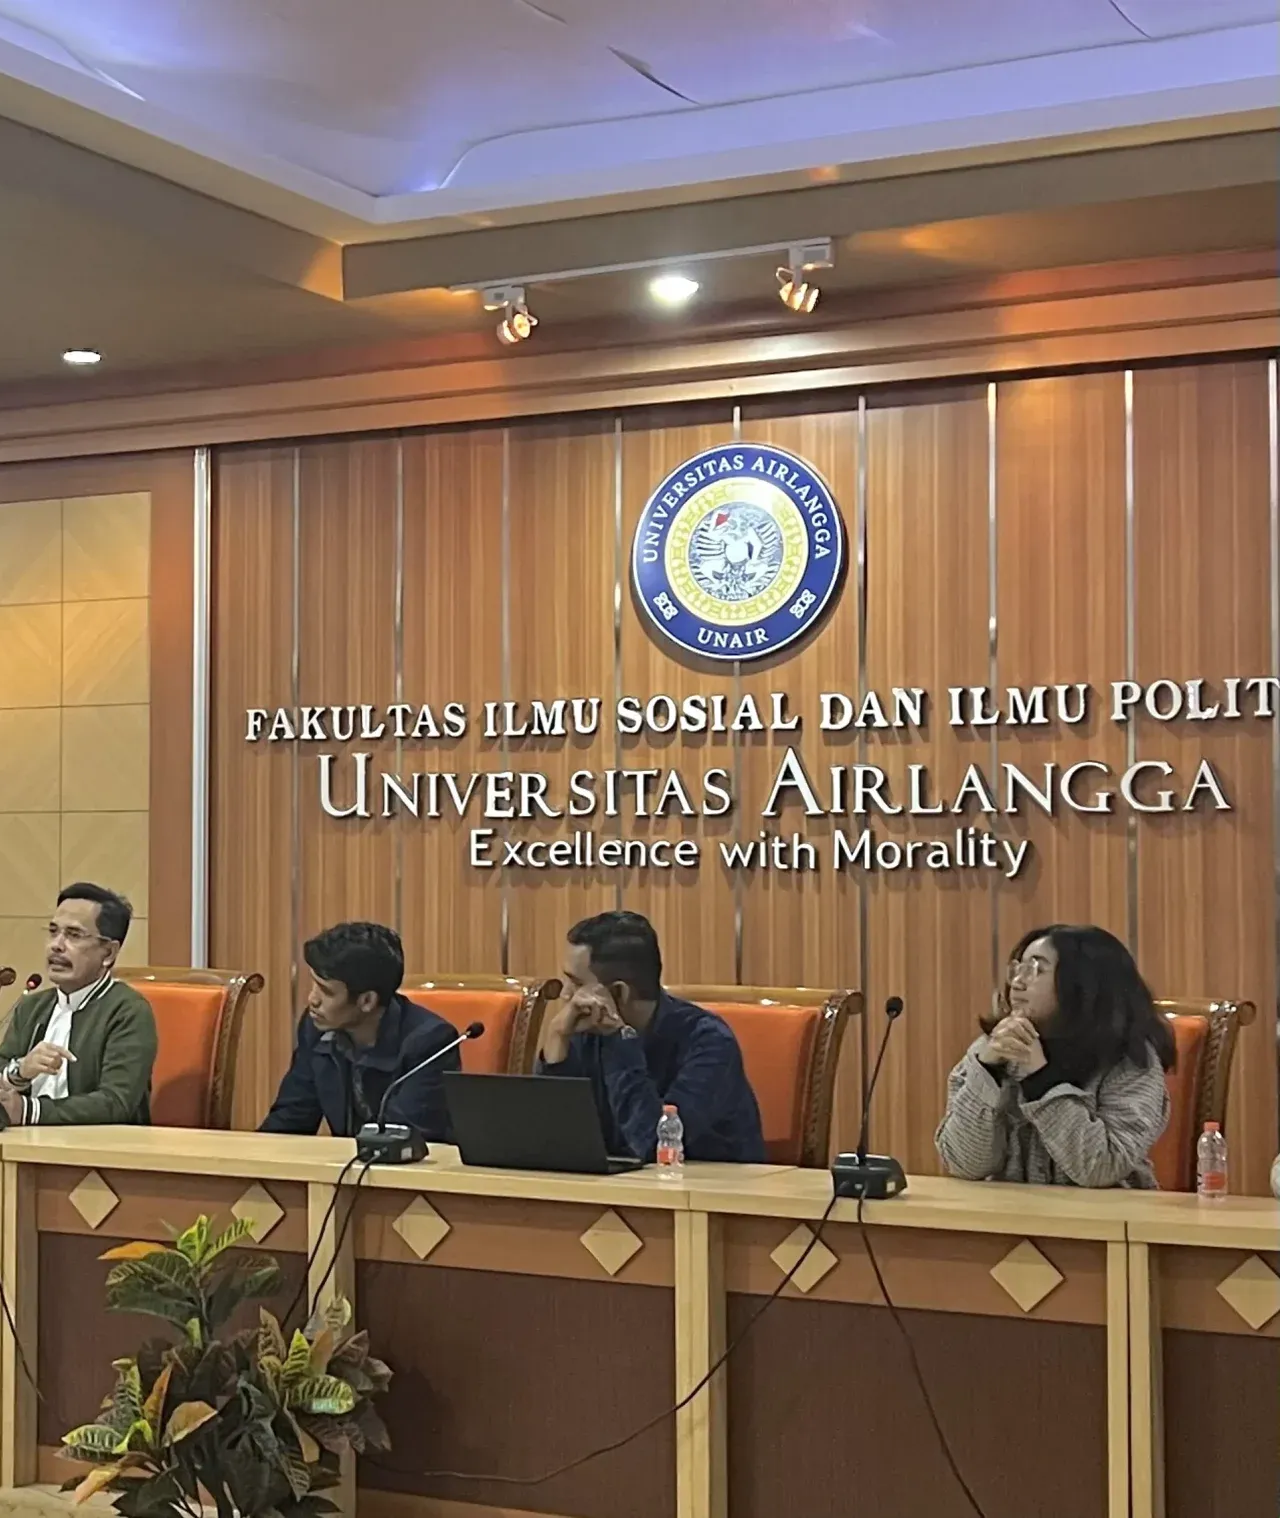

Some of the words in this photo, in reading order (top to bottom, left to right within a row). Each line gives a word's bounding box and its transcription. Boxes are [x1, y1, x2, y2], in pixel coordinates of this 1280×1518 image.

[643, 454, 745, 563] UNIVERSITAS
[751, 456, 832, 560] AIRLANGGA
[697, 626, 770, 649] UNAIR
[245, 702, 467, 742] FAKULTAS
[484, 697, 601, 738] ILMU
[617, 692, 800, 734] SOSIAL
[819, 687, 925, 732] DAN
[948, 683, 1088, 727] ILMU
[317, 751, 733, 819] UNIVERSITAS
[760, 746, 1233, 818] AIRLANGGA
[468, 828, 700, 869] Excellence
[719, 829, 817, 870] with
[832, 829, 1029, 878] Morality
